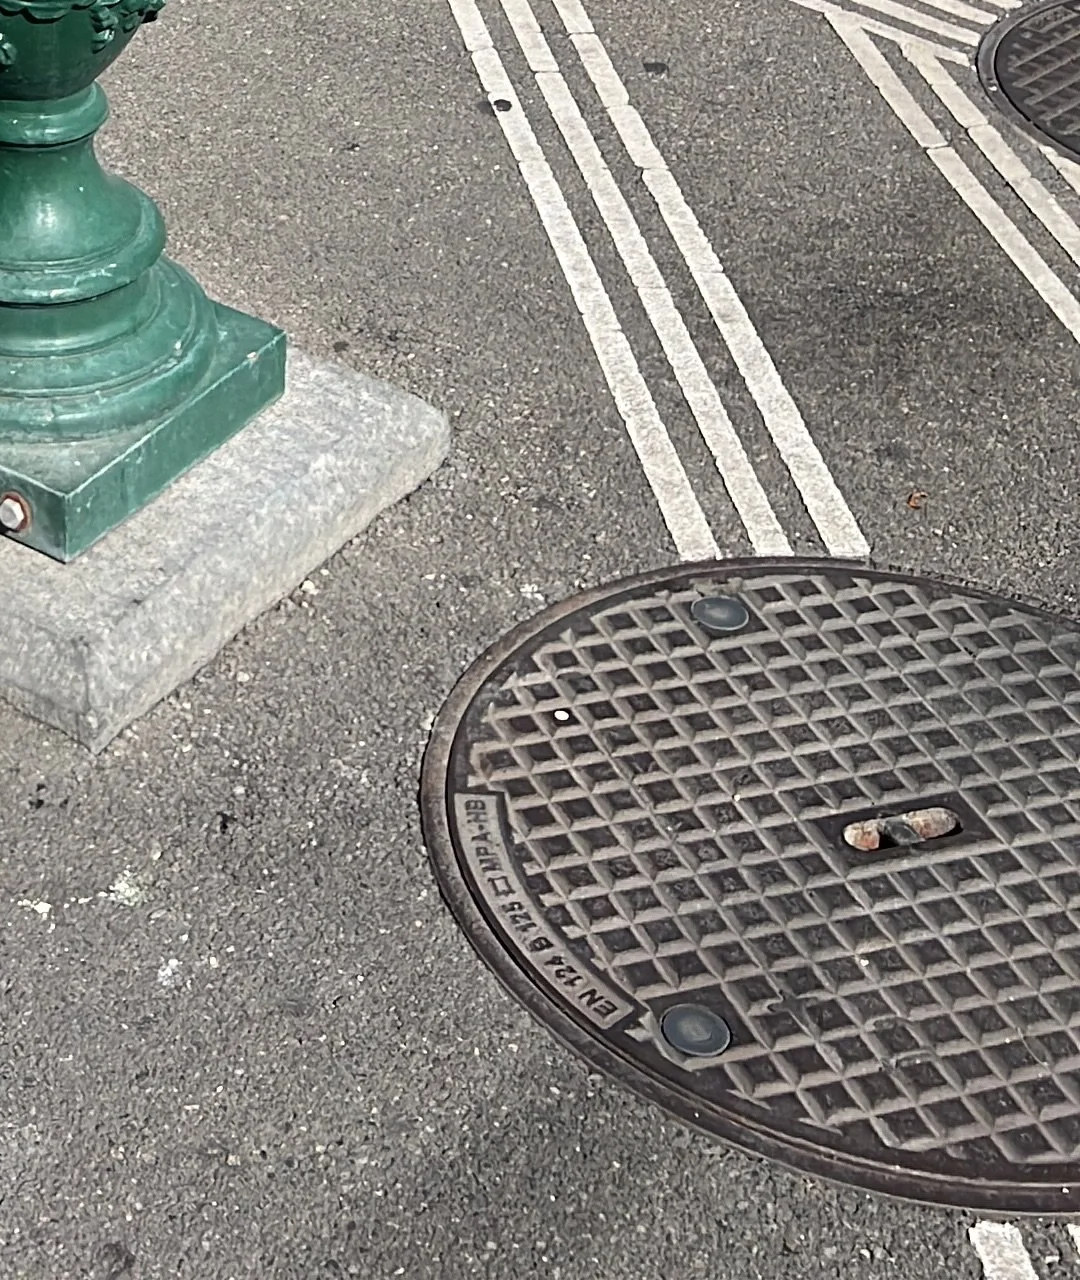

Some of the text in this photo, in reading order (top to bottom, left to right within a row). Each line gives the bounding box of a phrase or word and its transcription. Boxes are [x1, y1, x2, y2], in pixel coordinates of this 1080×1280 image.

[502, 901, 537, 933] 125
[528, 936, 555, 952] B
[544, 955, 584, 988] 124
[579, 989, 619, 1018] EN
